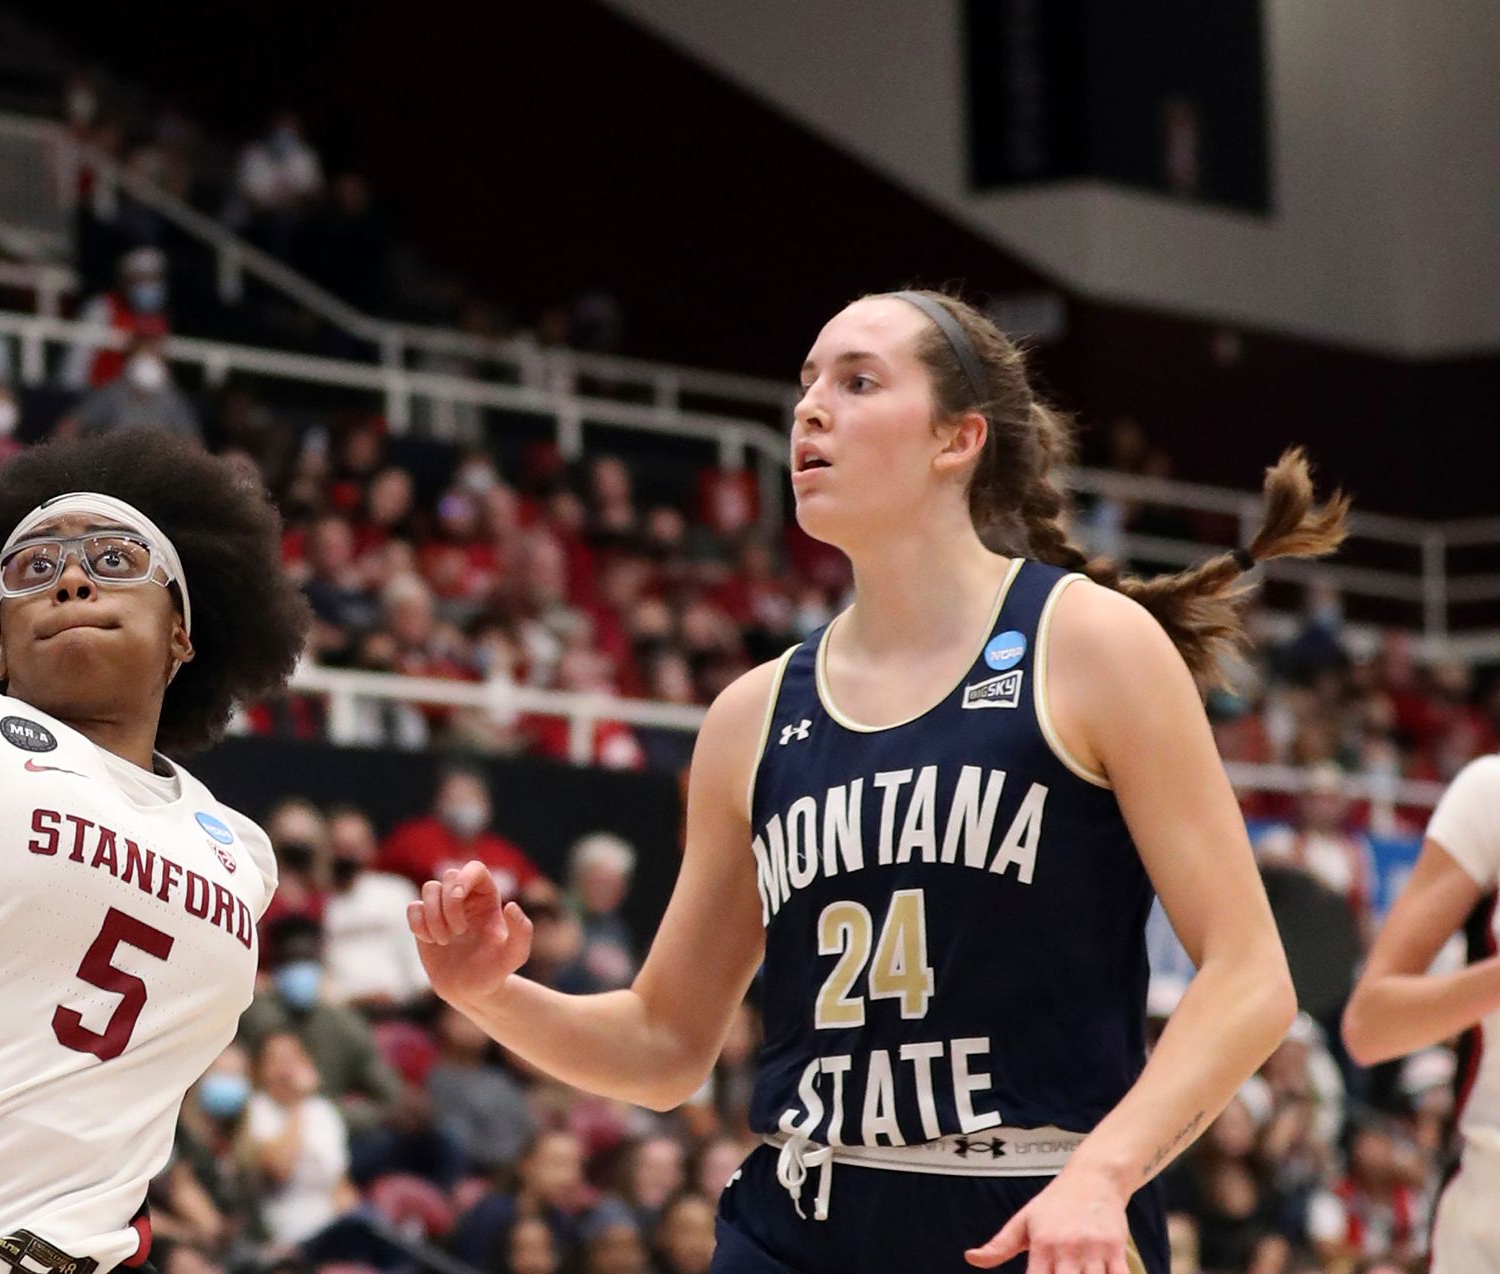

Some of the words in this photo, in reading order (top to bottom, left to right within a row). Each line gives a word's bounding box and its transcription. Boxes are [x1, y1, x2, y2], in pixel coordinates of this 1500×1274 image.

[991, 647, 1023, 660] NCAA
[28, 808, 252, 951] STANFORD
[752, 765, 1049, 928] MONTANA
[51, 906, 175, 1062] 5
[814, 888, 935, 1030] 24
[778, 1037, 1002, 1147] STATE
[1015, 1141, 1080, 1154] RMOUR
